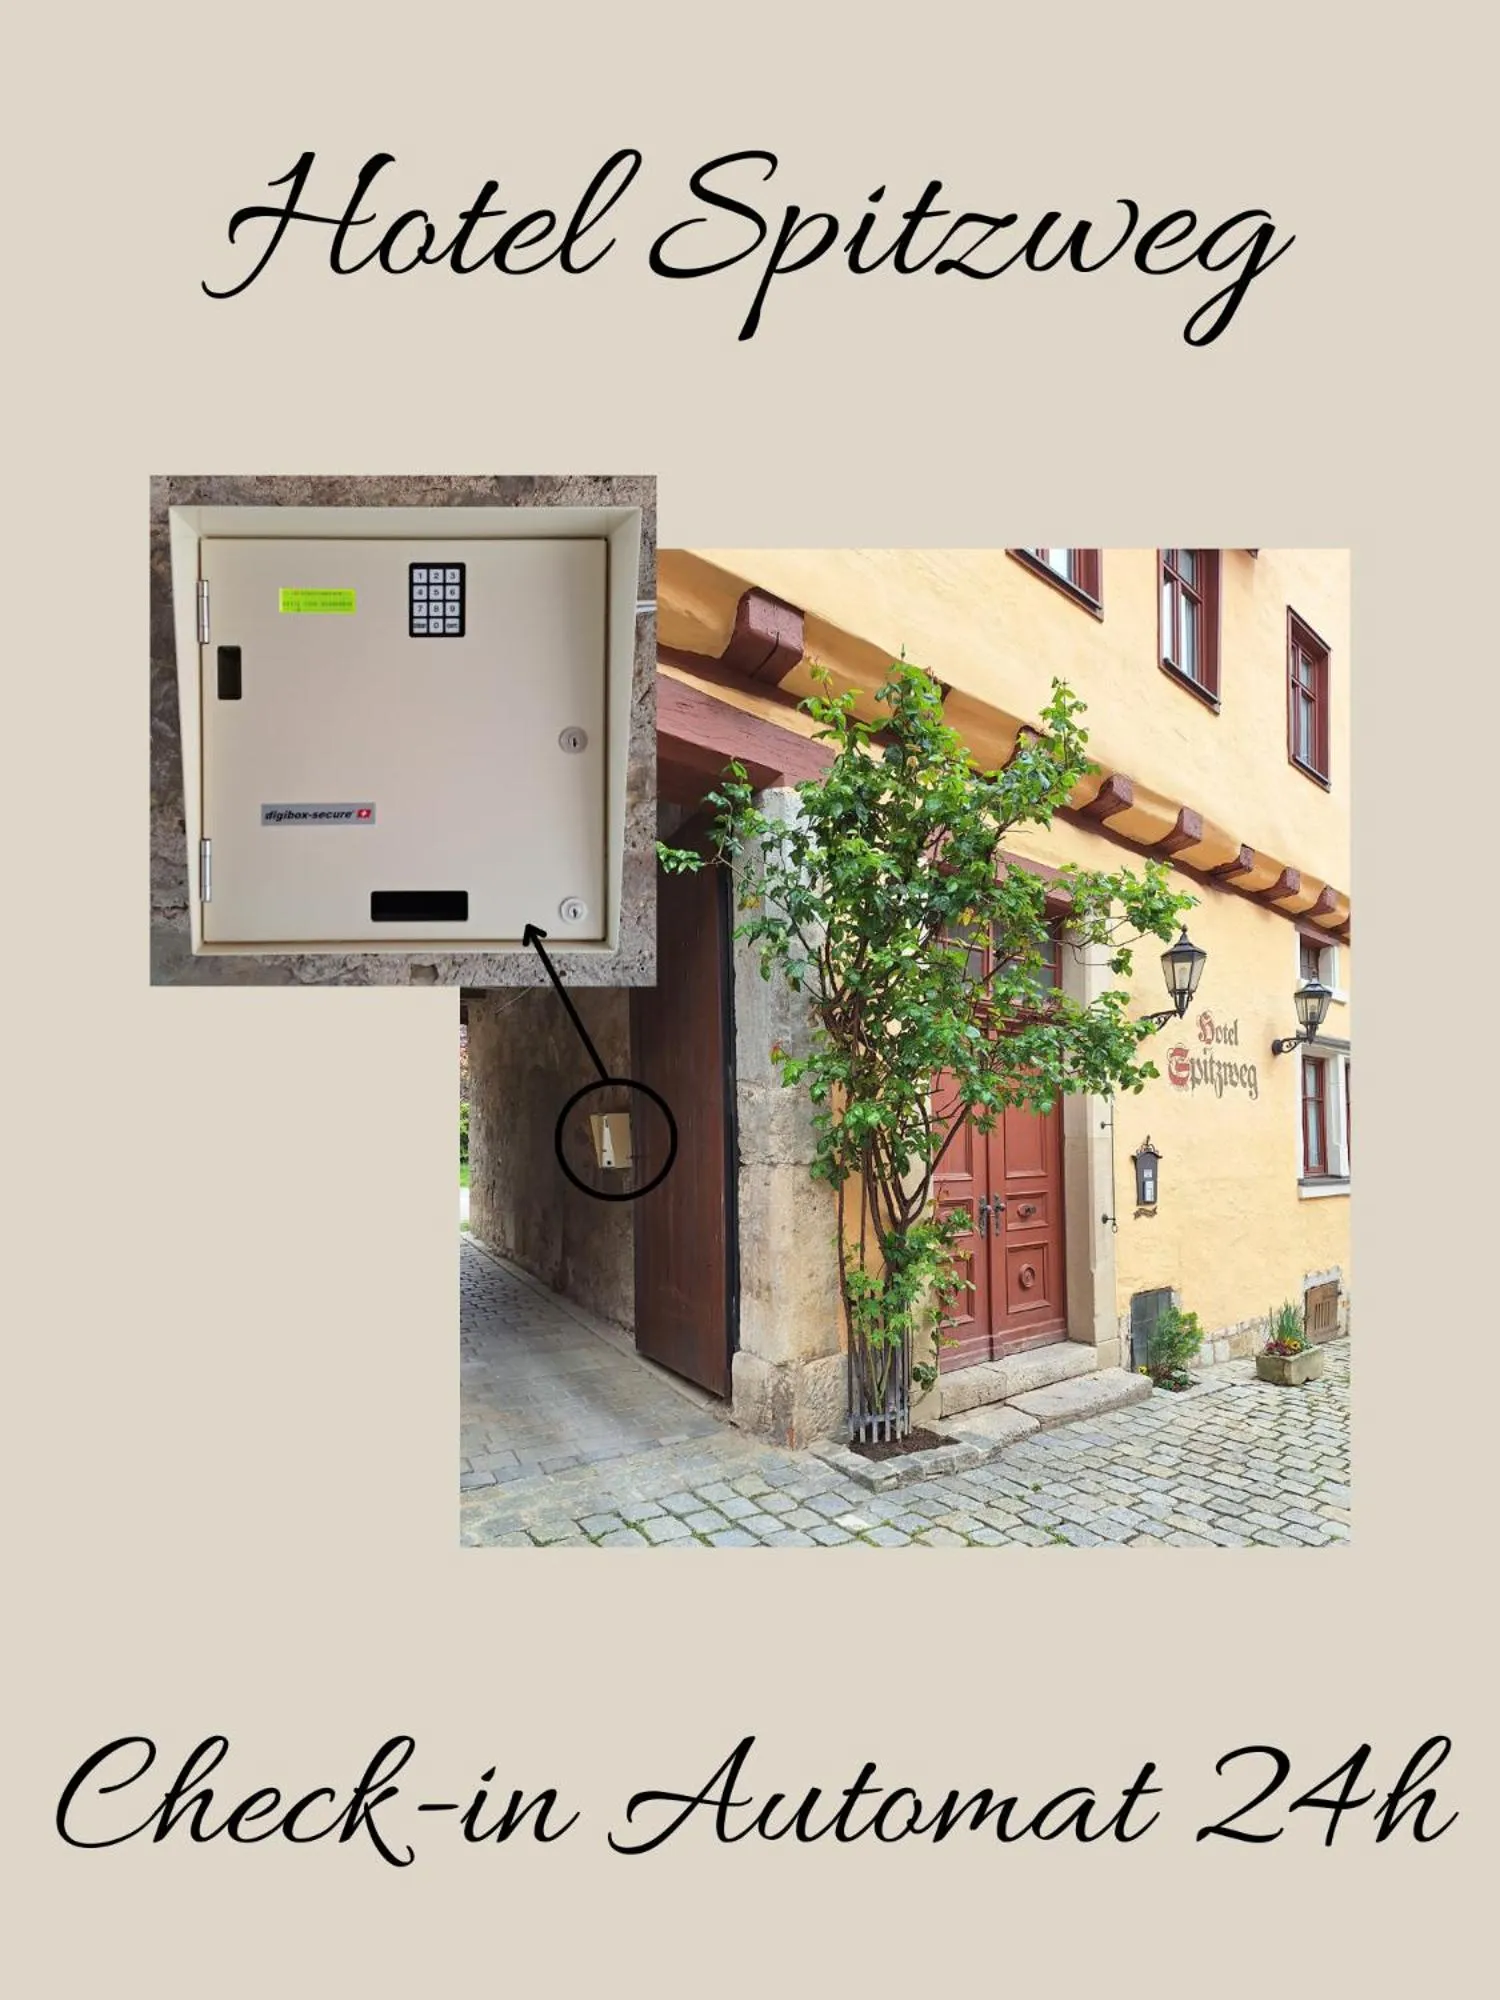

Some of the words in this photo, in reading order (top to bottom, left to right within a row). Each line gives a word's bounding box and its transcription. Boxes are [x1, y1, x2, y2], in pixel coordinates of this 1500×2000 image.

[264, 808, 353, 822] digibox-secure
[1196, 1010, 1239, 1046] Hotel
[1167, 1043, 1258, 1101] Spitzweg
